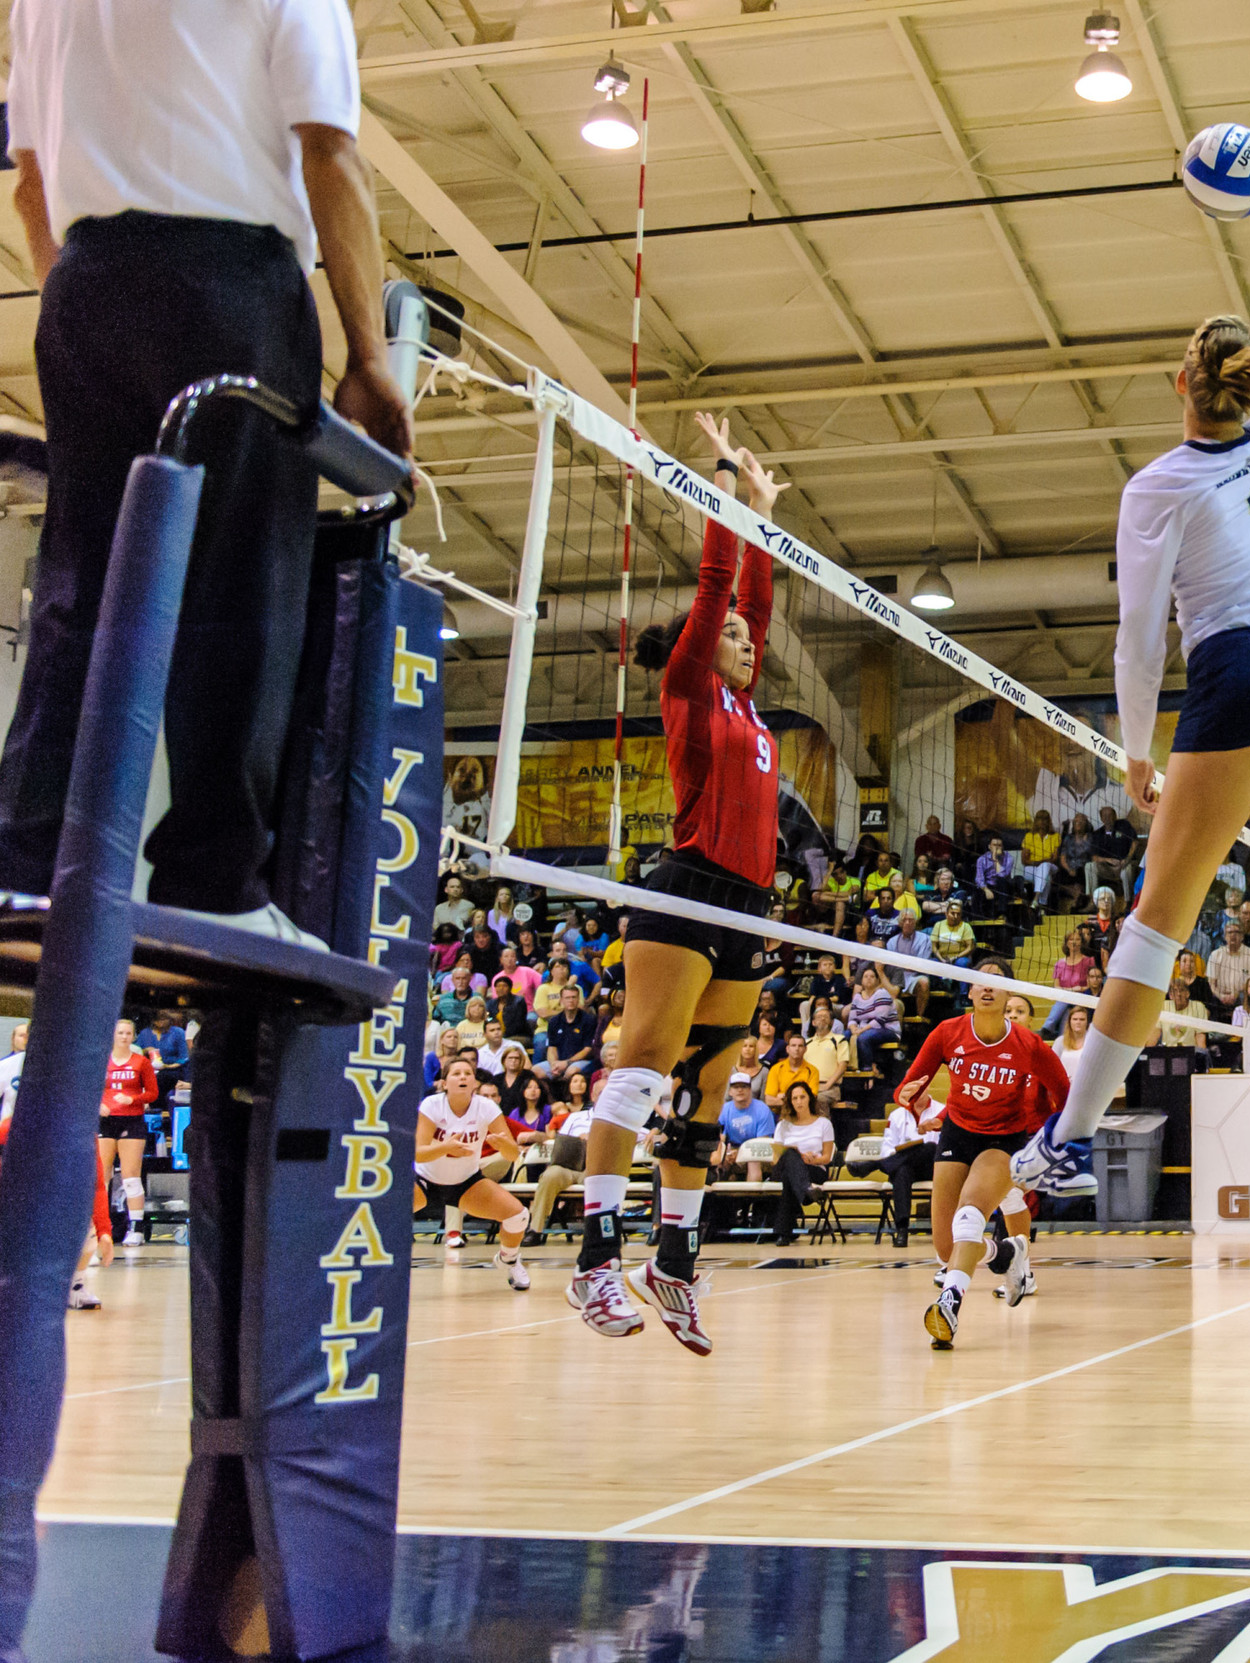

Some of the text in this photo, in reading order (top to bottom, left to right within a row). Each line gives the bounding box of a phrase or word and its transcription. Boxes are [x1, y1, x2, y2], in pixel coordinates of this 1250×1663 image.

[756, 734, 771, 774] 9
[968, 1062, 1017, 1085] STATE
[1106, 1132, 1126, 1147] GT
